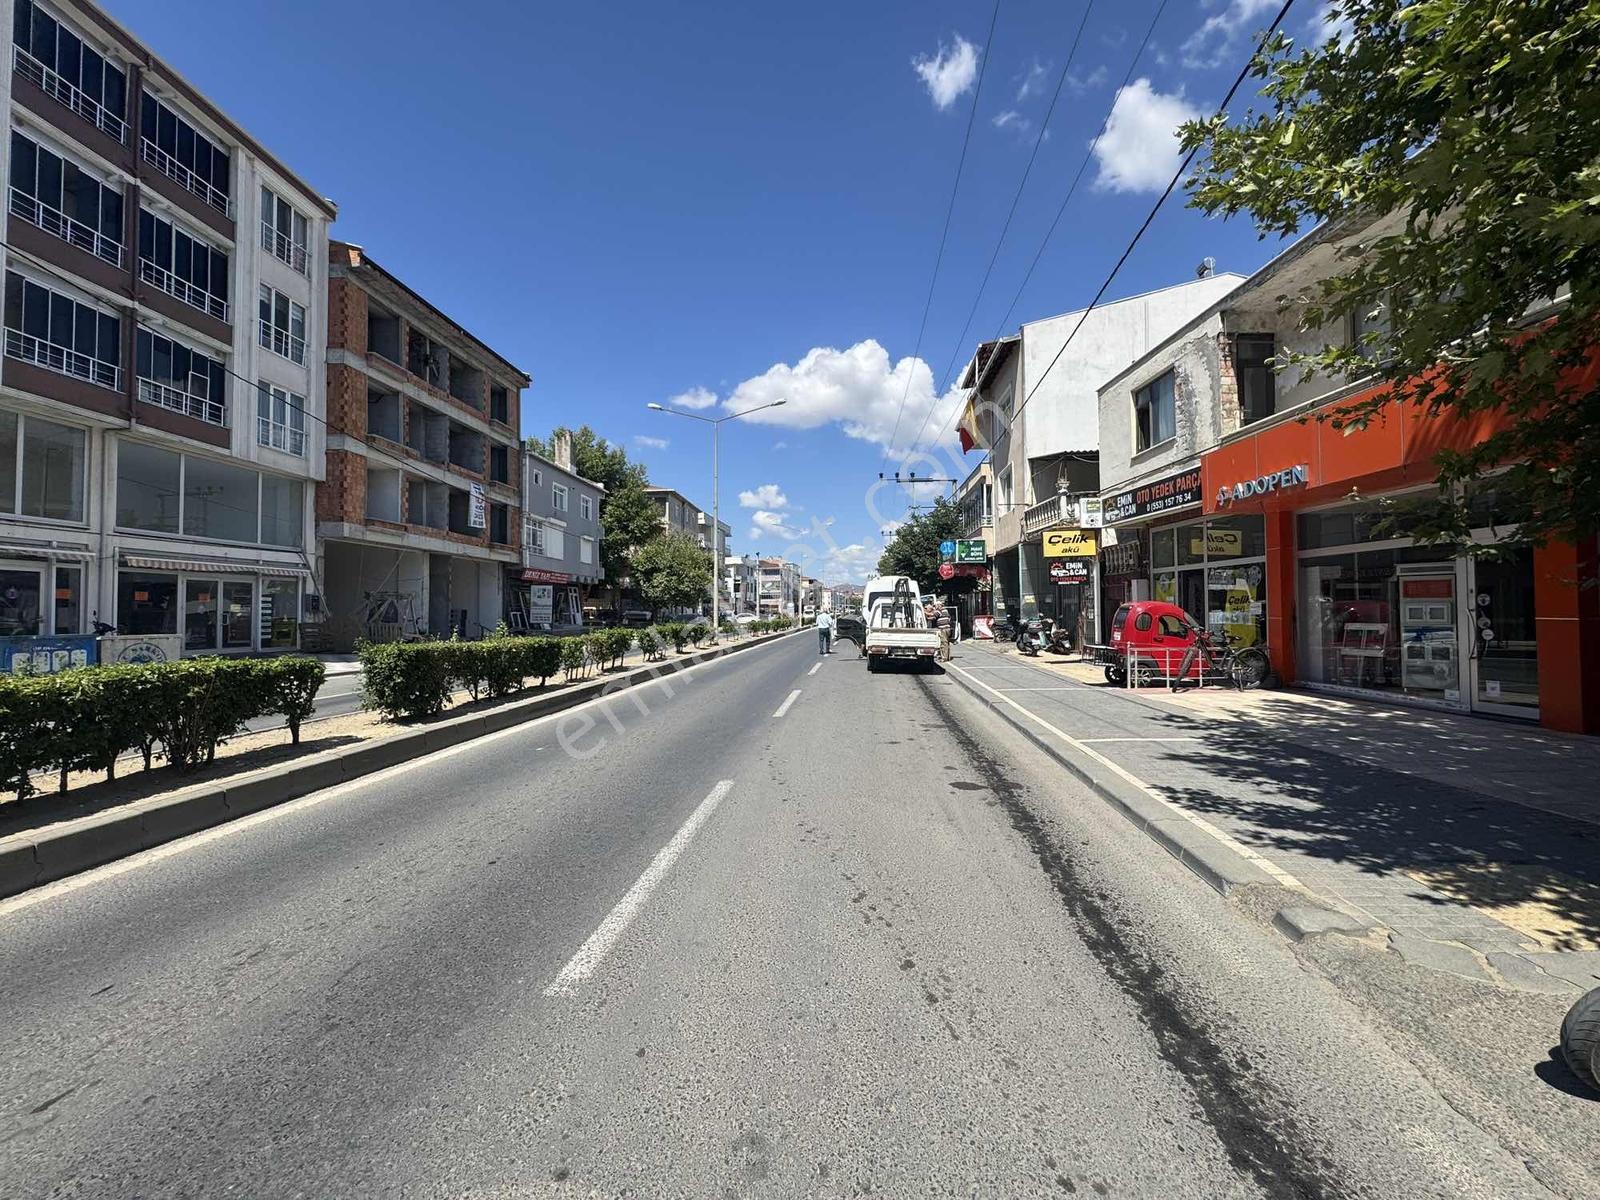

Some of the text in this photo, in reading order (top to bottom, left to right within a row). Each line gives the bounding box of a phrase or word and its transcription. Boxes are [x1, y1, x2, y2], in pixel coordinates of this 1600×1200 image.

[1136, 490, 1150, 504] OTO
[1151, 481, 1174, 500] YEDEK
[1232, 464, 1308, 501] ADOPEN
[1165, 497, 1175, 507] 157
[1184, 491, 1191, 501] 34
